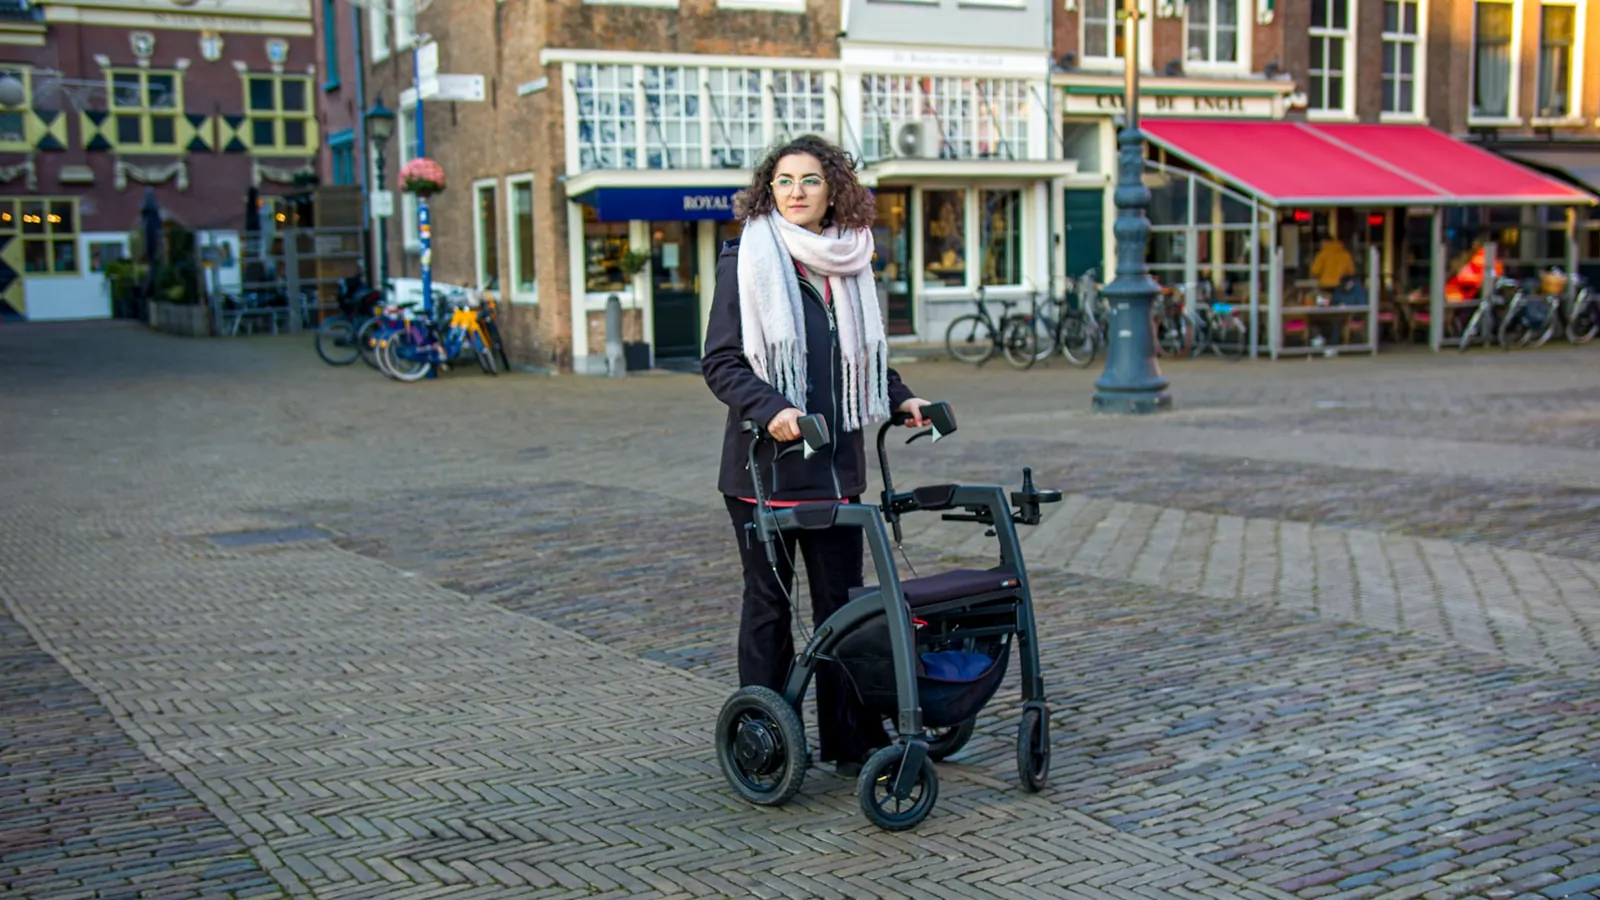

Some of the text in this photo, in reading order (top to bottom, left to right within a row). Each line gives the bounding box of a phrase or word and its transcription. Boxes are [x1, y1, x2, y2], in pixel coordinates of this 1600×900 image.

[1154, 93, 1177, 111] DE
[1192, 94, 1246, 112] ENGEL
[683, 195, 730, 211] ROYAL
